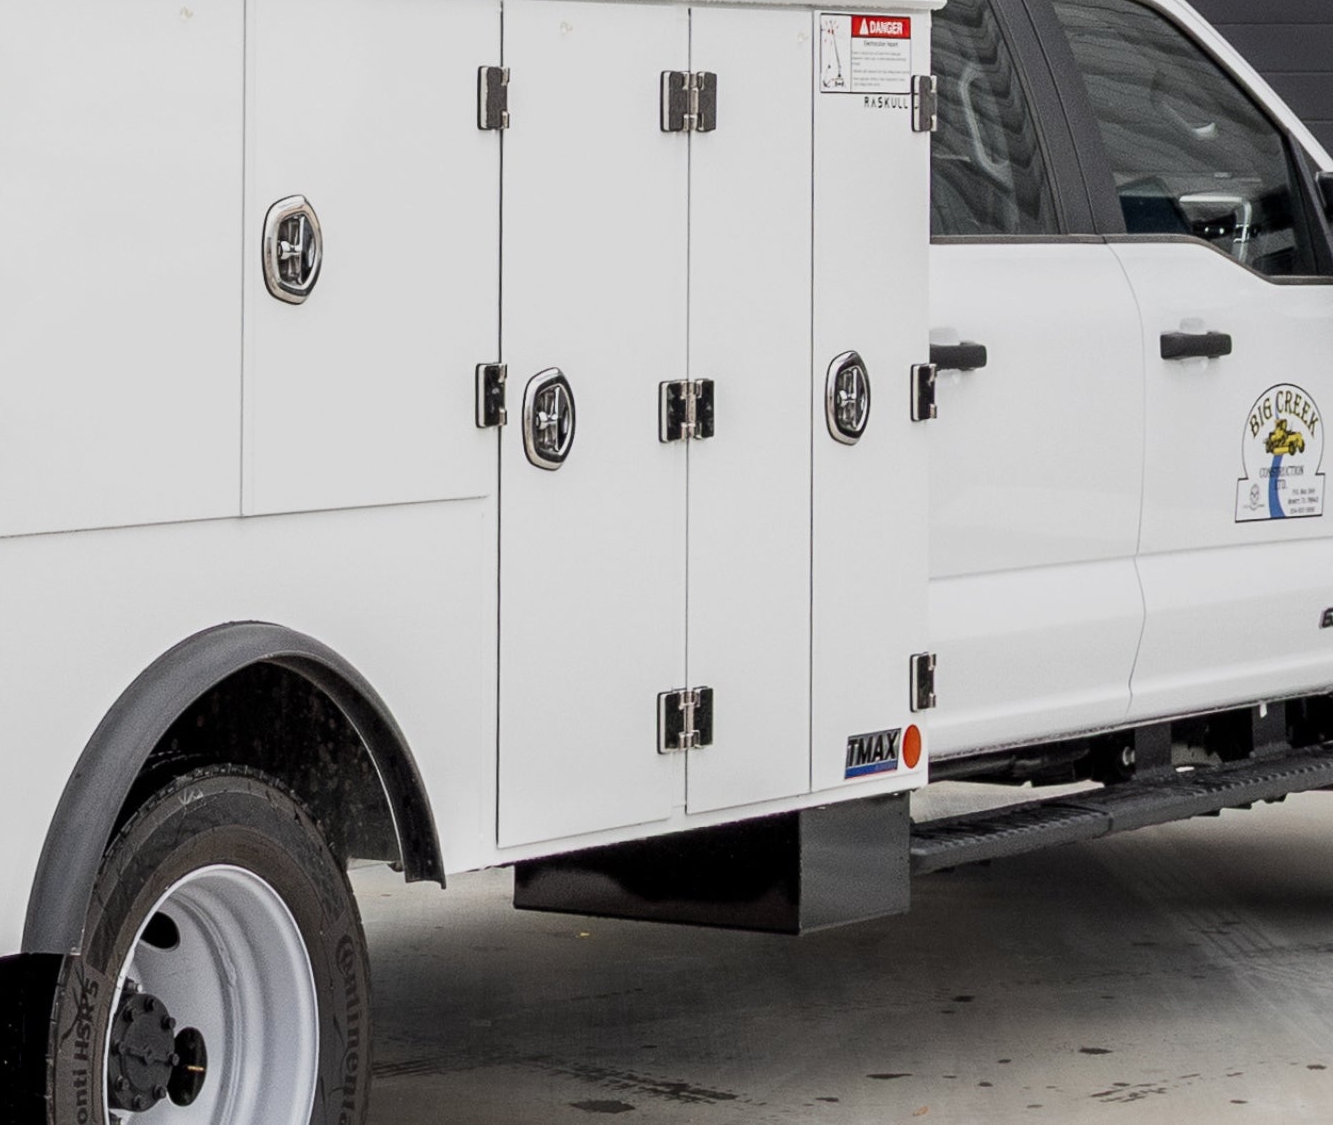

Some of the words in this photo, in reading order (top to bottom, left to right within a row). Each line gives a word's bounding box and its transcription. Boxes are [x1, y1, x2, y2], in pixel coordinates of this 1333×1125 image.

[869, 20, 904, 35] DANGER
[864, 96, 909, 110] RASKULL
[1249, 397, 1273, 439] BIG
[1275, 390, 1319, 437] CREEK
[847, 731, 899, 767] TMAX
[336, 935, 361, 1125] Continenta
[73, 1069, 88, 1125] onti
